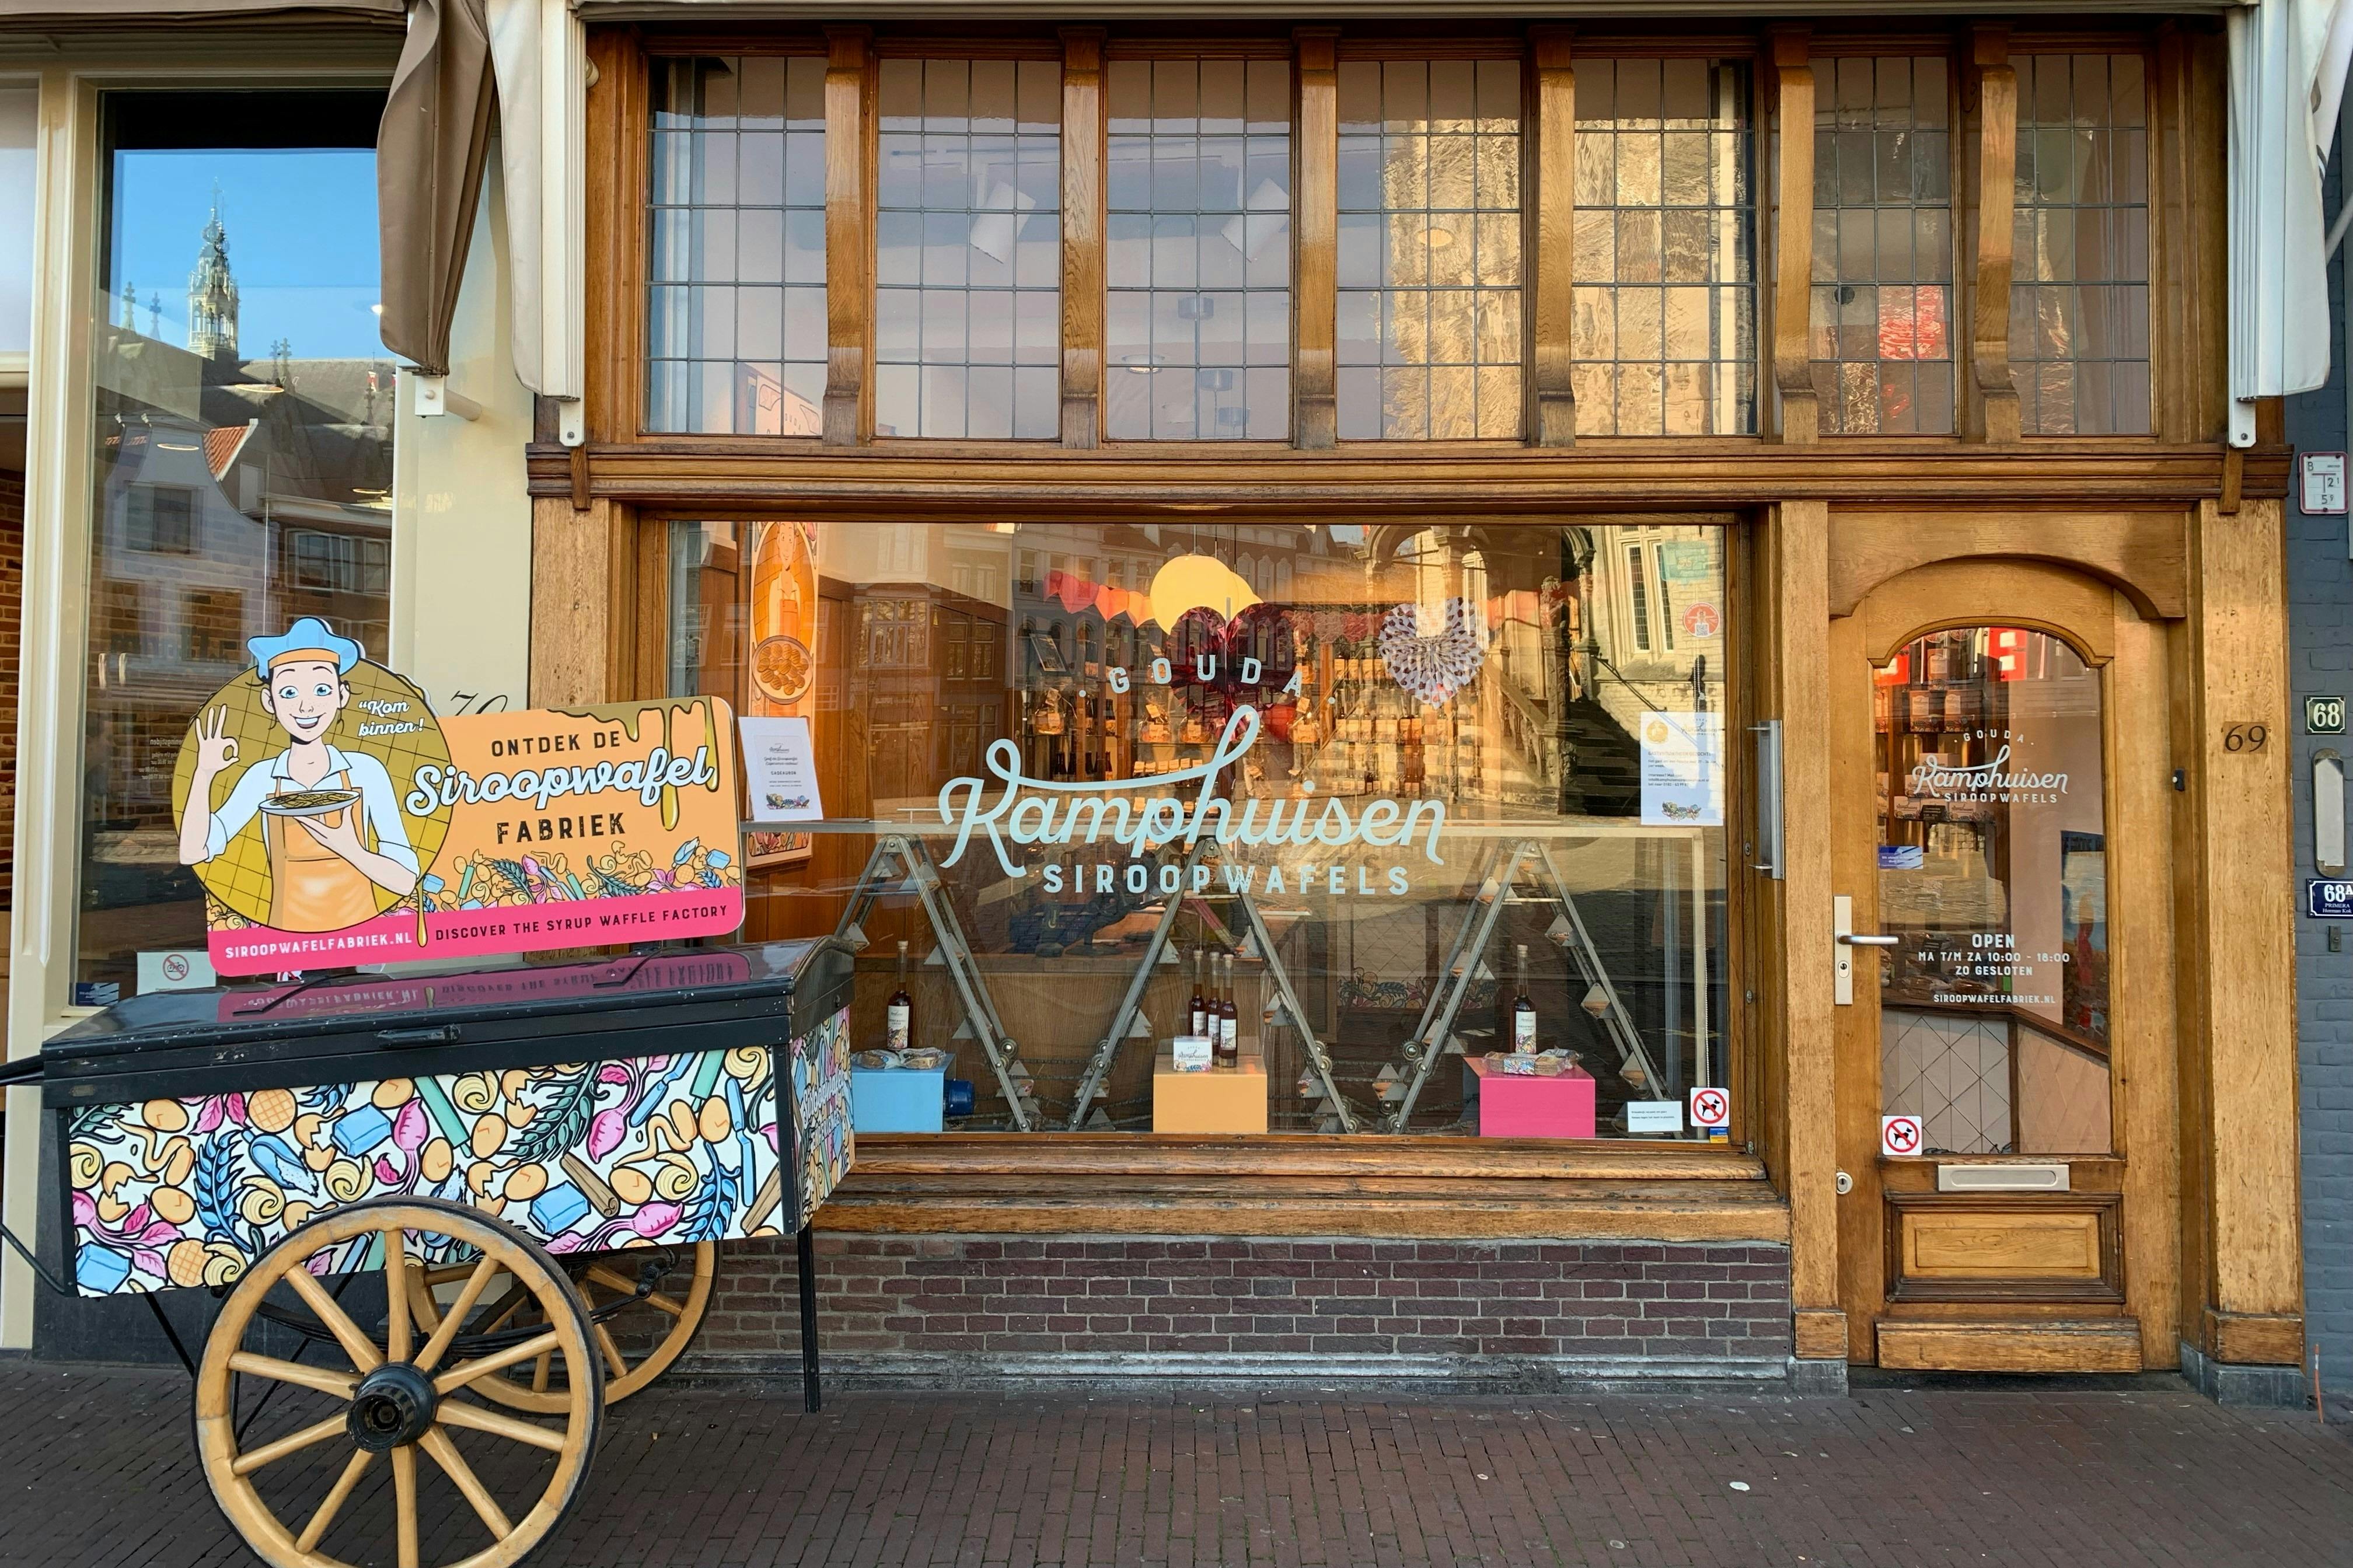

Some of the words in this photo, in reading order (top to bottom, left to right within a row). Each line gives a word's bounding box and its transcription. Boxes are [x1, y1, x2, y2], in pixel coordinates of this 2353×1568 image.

[2307, 462, 2314, 471] B
[1109, 655, 1303, 697] GOUDA
[2313, 703, 2340, 727] 68
[491, 734, 578, 757] ONTDEK
[594, 731, 620, 748] DE
[1963, 729, 2024, 743] GOUDA
[2225, 724, 2267, 752] 69
[405, 746, 714, 816] Siroopwafel
[1912, 744, 2068, 797] Kamphuisen
[939, 704, 1445, 878] Kamphuisen
[1944, 792, 2058, 803] SIROOPWAFELS
[498, 812, 625, 844] FABRIEK
[1044, 865, 1409, 895] SIROOPWAFELS
[436, 924, 505, 941] DISCOVER
[514, 921, 539, 935] THE
[546, 917, 592, 932] SYRUP
[599, 911, 655, 927] WAFFLE
[663, 905, 728, 920] FACTORY
[225, 931, 412, 959] SIROOPWAFELFABRIEK.NL
[1972, 934, 2015, 948] OPEN
[1918, 952, 1935, 961] MA
[1940, 952, 1961, 962] T/M
[1967, 952, 1982, 962] ZA
[1988, 952, 2021, 962] 10:00
[1955, 966, 1970, 975] ZO
[1975, 966, 2033, 976] GESLOTEN
[1933, 995, 2056, 1004] SIROOPWAFELFABRIEK.NL
